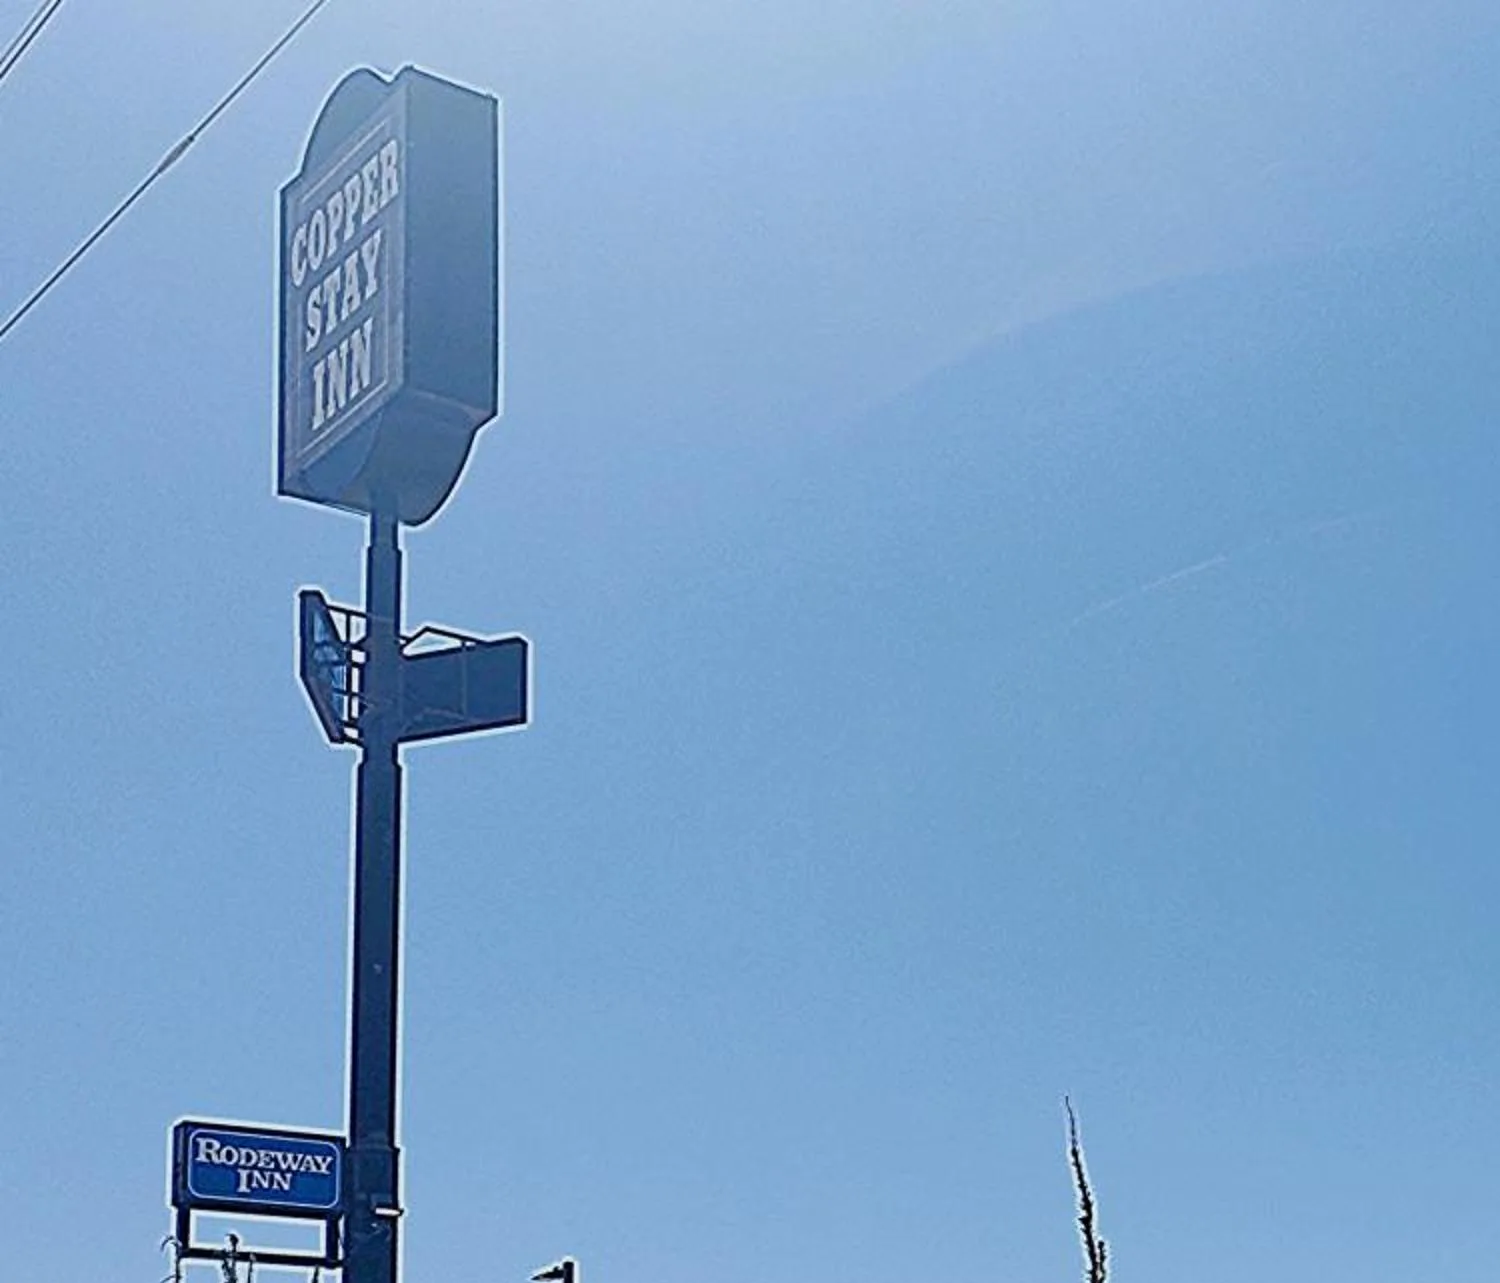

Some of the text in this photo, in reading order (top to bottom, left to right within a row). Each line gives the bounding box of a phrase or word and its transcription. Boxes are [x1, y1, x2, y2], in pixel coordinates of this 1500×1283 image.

[291, 139, 398, 287] COPPER
[306, 229, 382, 352] STAY
[312, 317, 373, 430] INN
[195, 1137, 333, 1174] RODEWAY
[237, 1168, 293, 1193] INN
